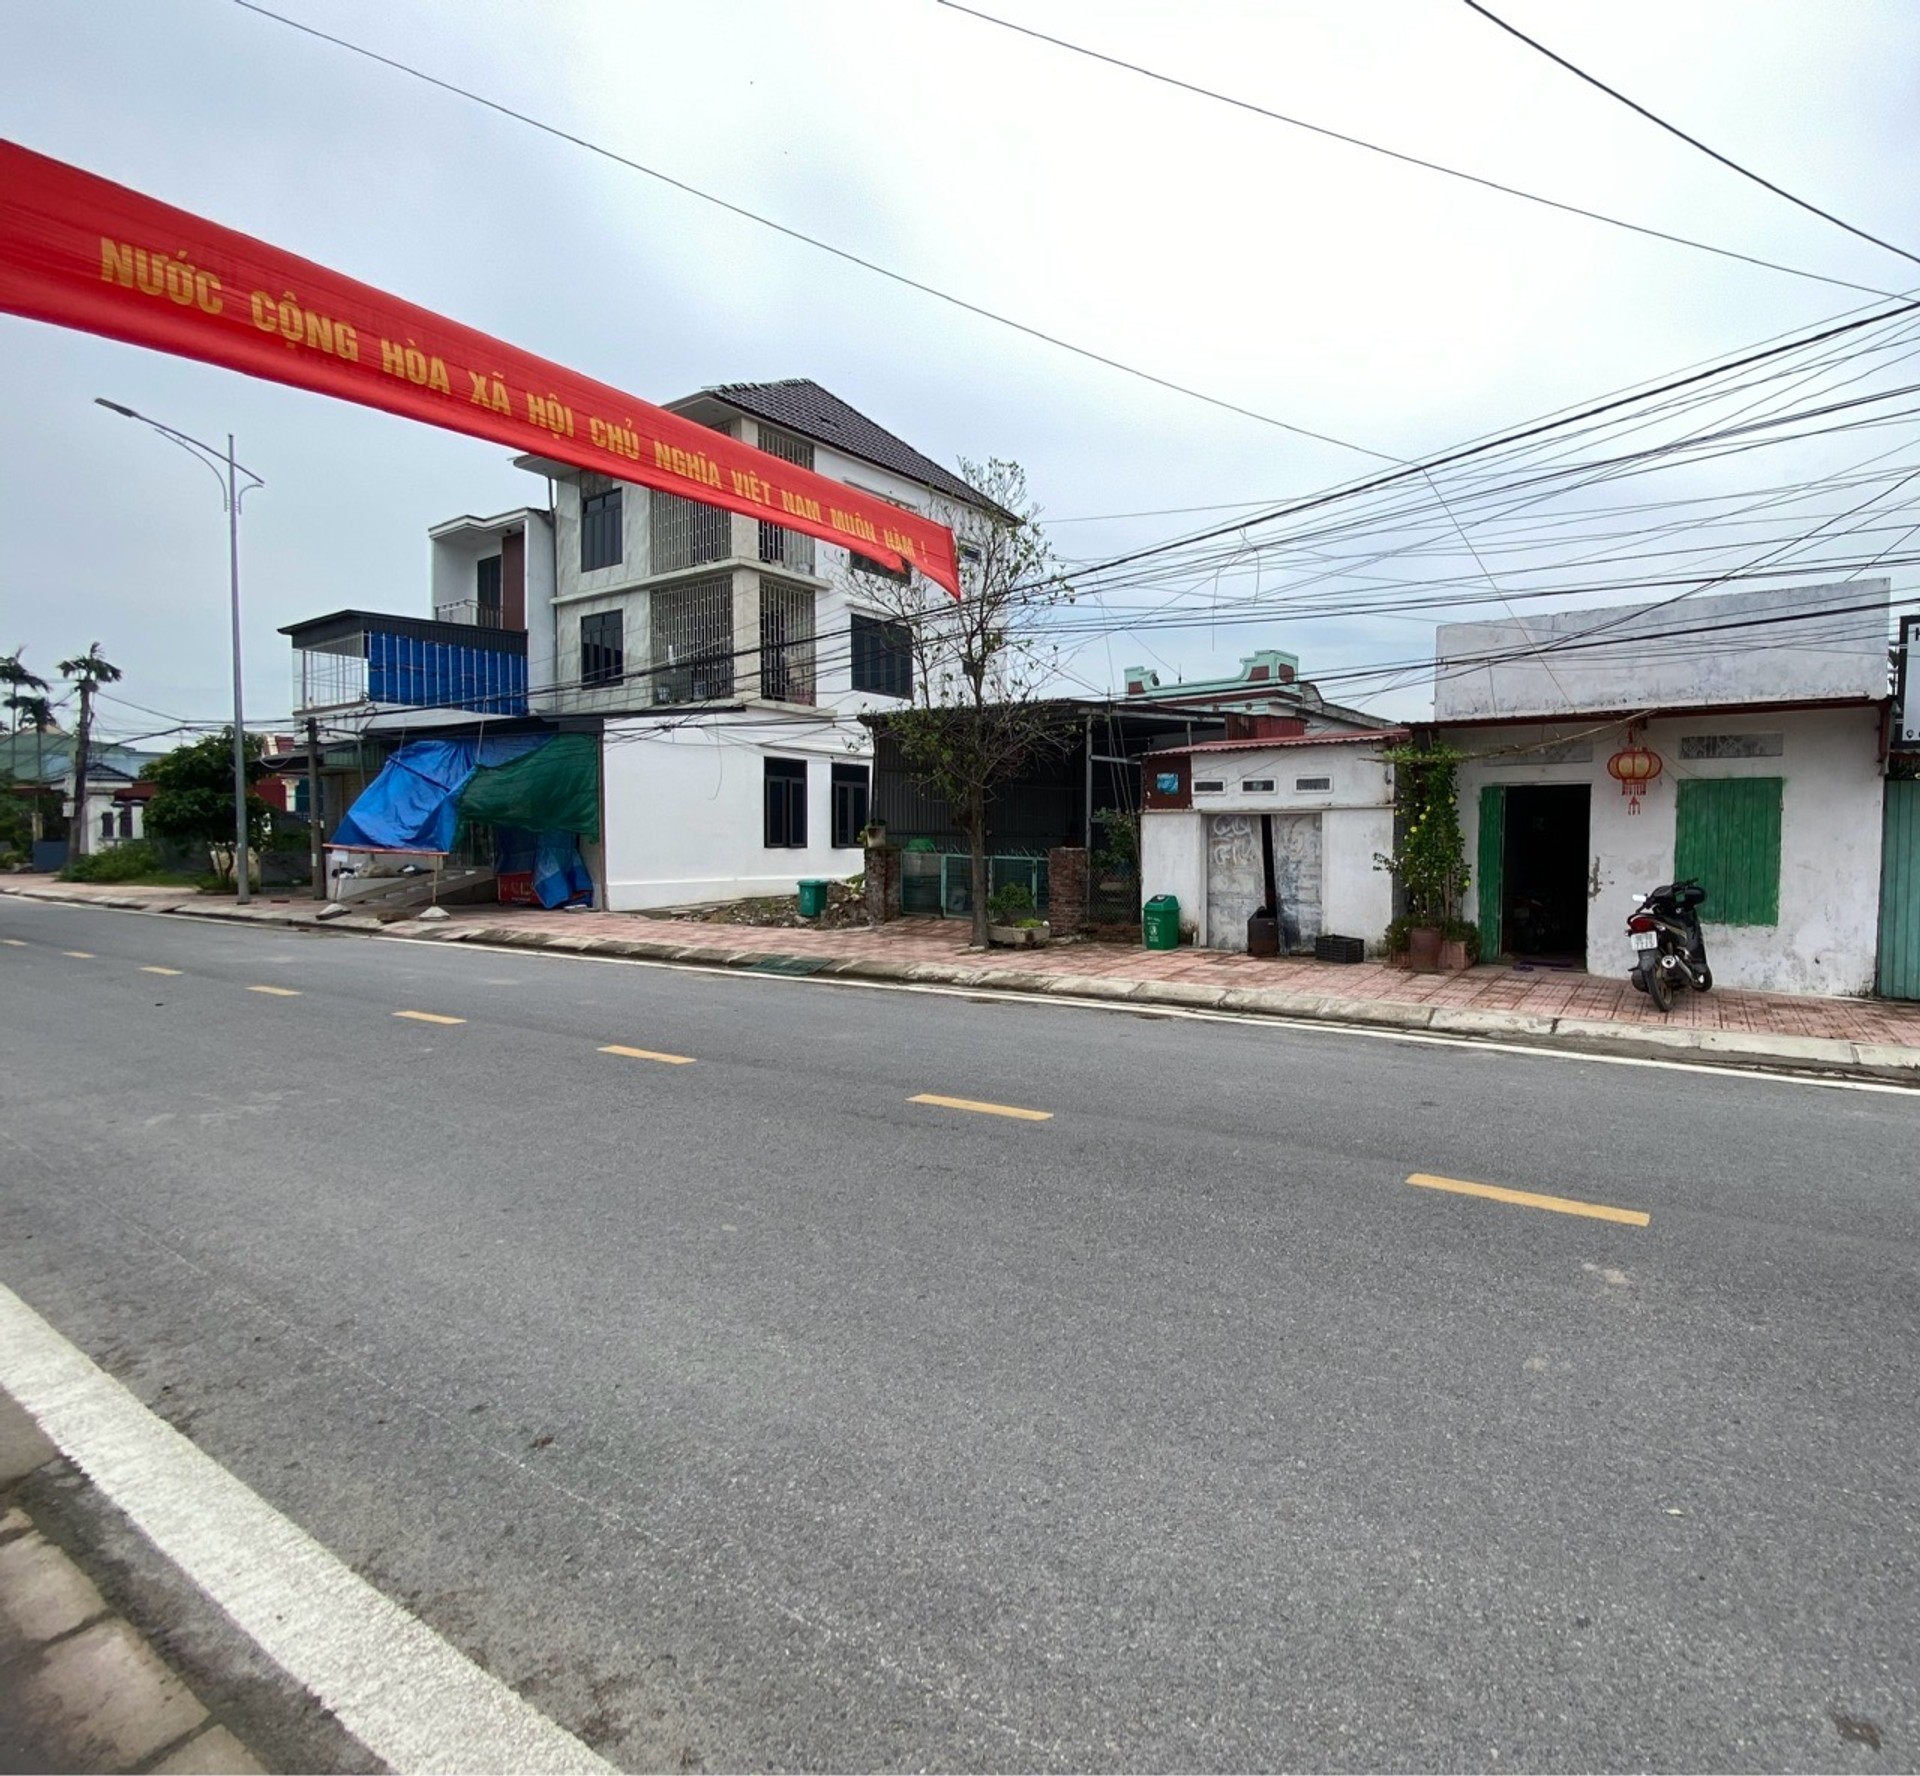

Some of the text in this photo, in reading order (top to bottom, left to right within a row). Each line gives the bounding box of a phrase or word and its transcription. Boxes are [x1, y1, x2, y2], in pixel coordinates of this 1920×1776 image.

[100, 236, 224, 315] NƯỚC
[249, 290, 359, 362] CỘNG
[380, 337, 451, 395] HÒA
[468, 371, 512, 416] XÃ
[526, 393, 577, 440] HỘI
[589, 417, 641, 460] CHỦ
[653, 440, 723, 489] NGHĨA
[730, 470, 771, 507] VIỆT
[781, 490, 823, 523] NAM
[830, 508, 877, 544] MUÔN
